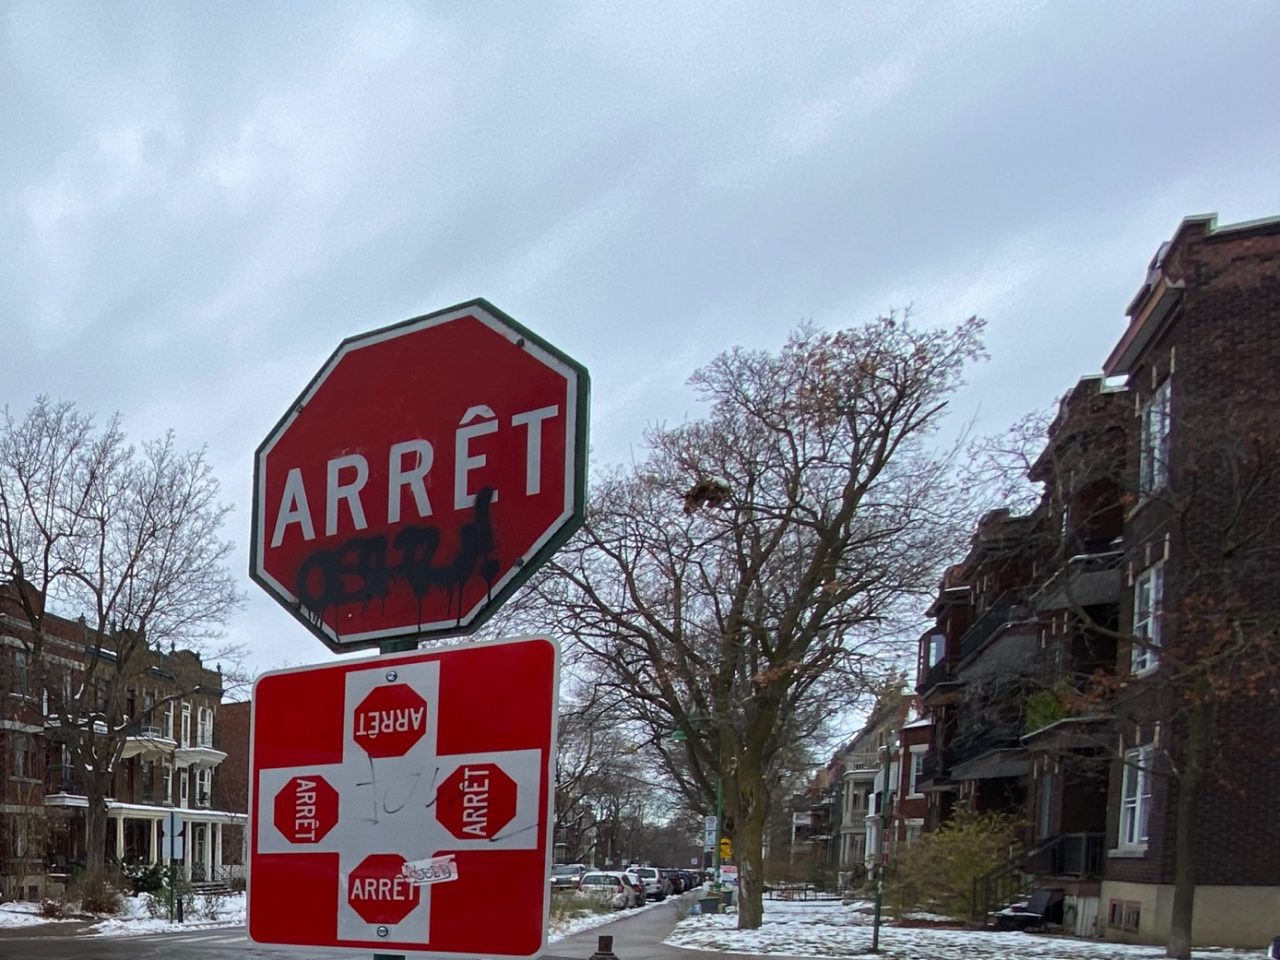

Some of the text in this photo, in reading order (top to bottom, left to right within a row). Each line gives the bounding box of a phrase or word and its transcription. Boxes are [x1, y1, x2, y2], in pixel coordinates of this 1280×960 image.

[270, 403, 559, 549] ARRÊT
[356, 706, 425, 738] ARRÊT
[295, 779, 319, 841] ARRÊT
[459, 767, 490, 836] ARRÊT
